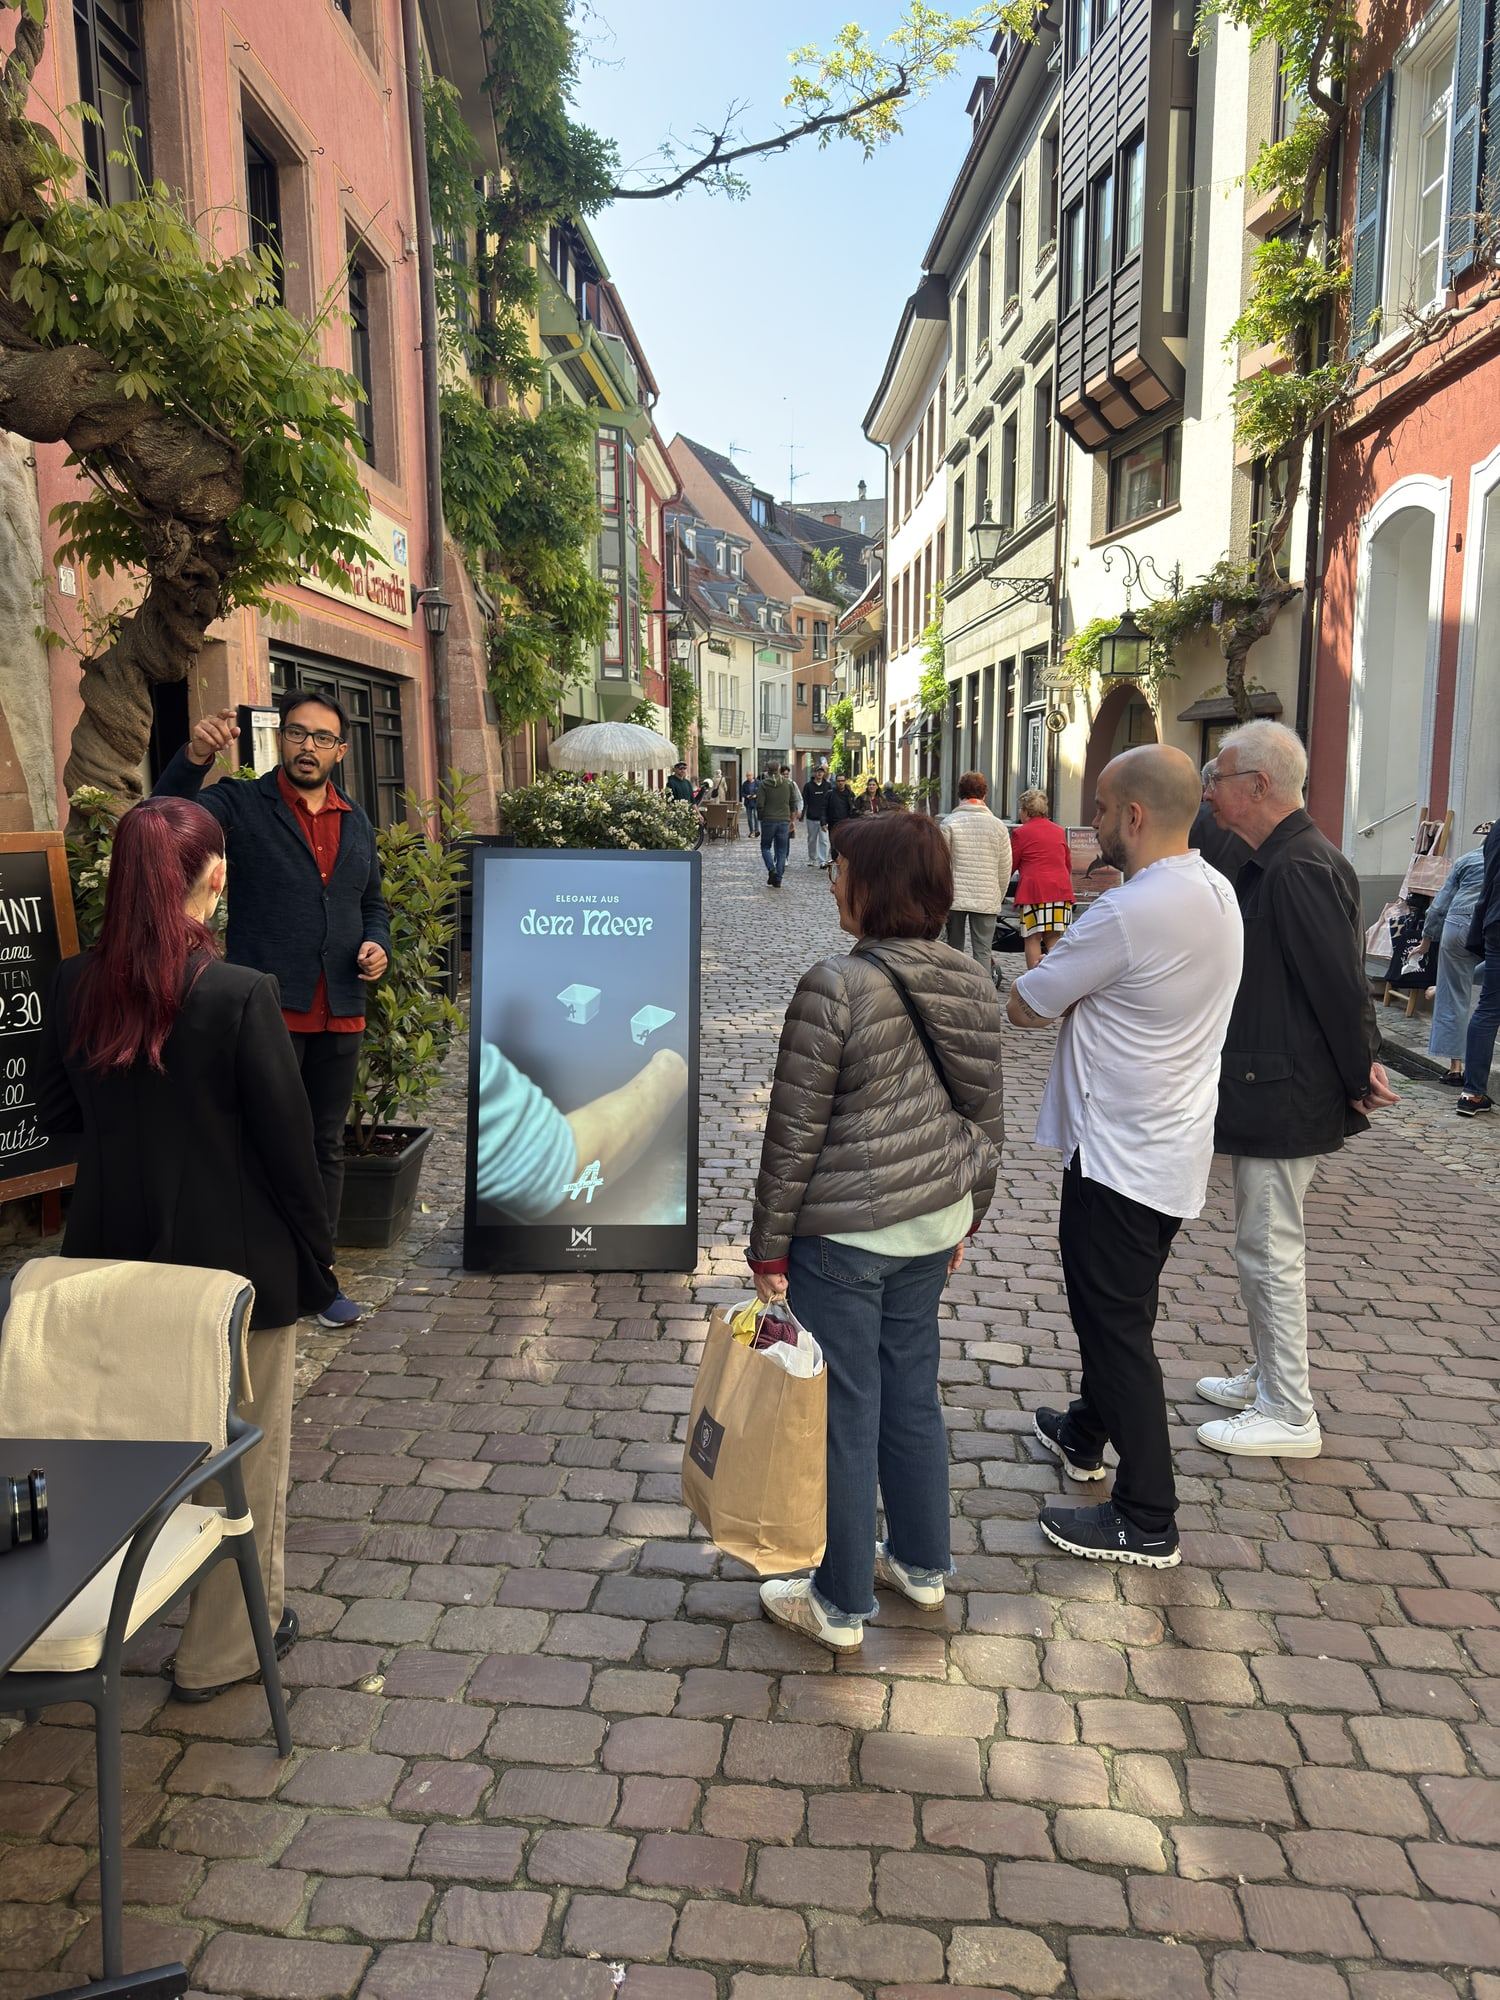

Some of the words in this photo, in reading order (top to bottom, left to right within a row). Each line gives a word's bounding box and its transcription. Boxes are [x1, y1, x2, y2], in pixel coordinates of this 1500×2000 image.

[1043, 672, 1074, 681] Frieur
[556, 895, 597, 903] ELEGANZ
[520, 909, 574, 935] dem
[582, 910, 654, 936] Meer
